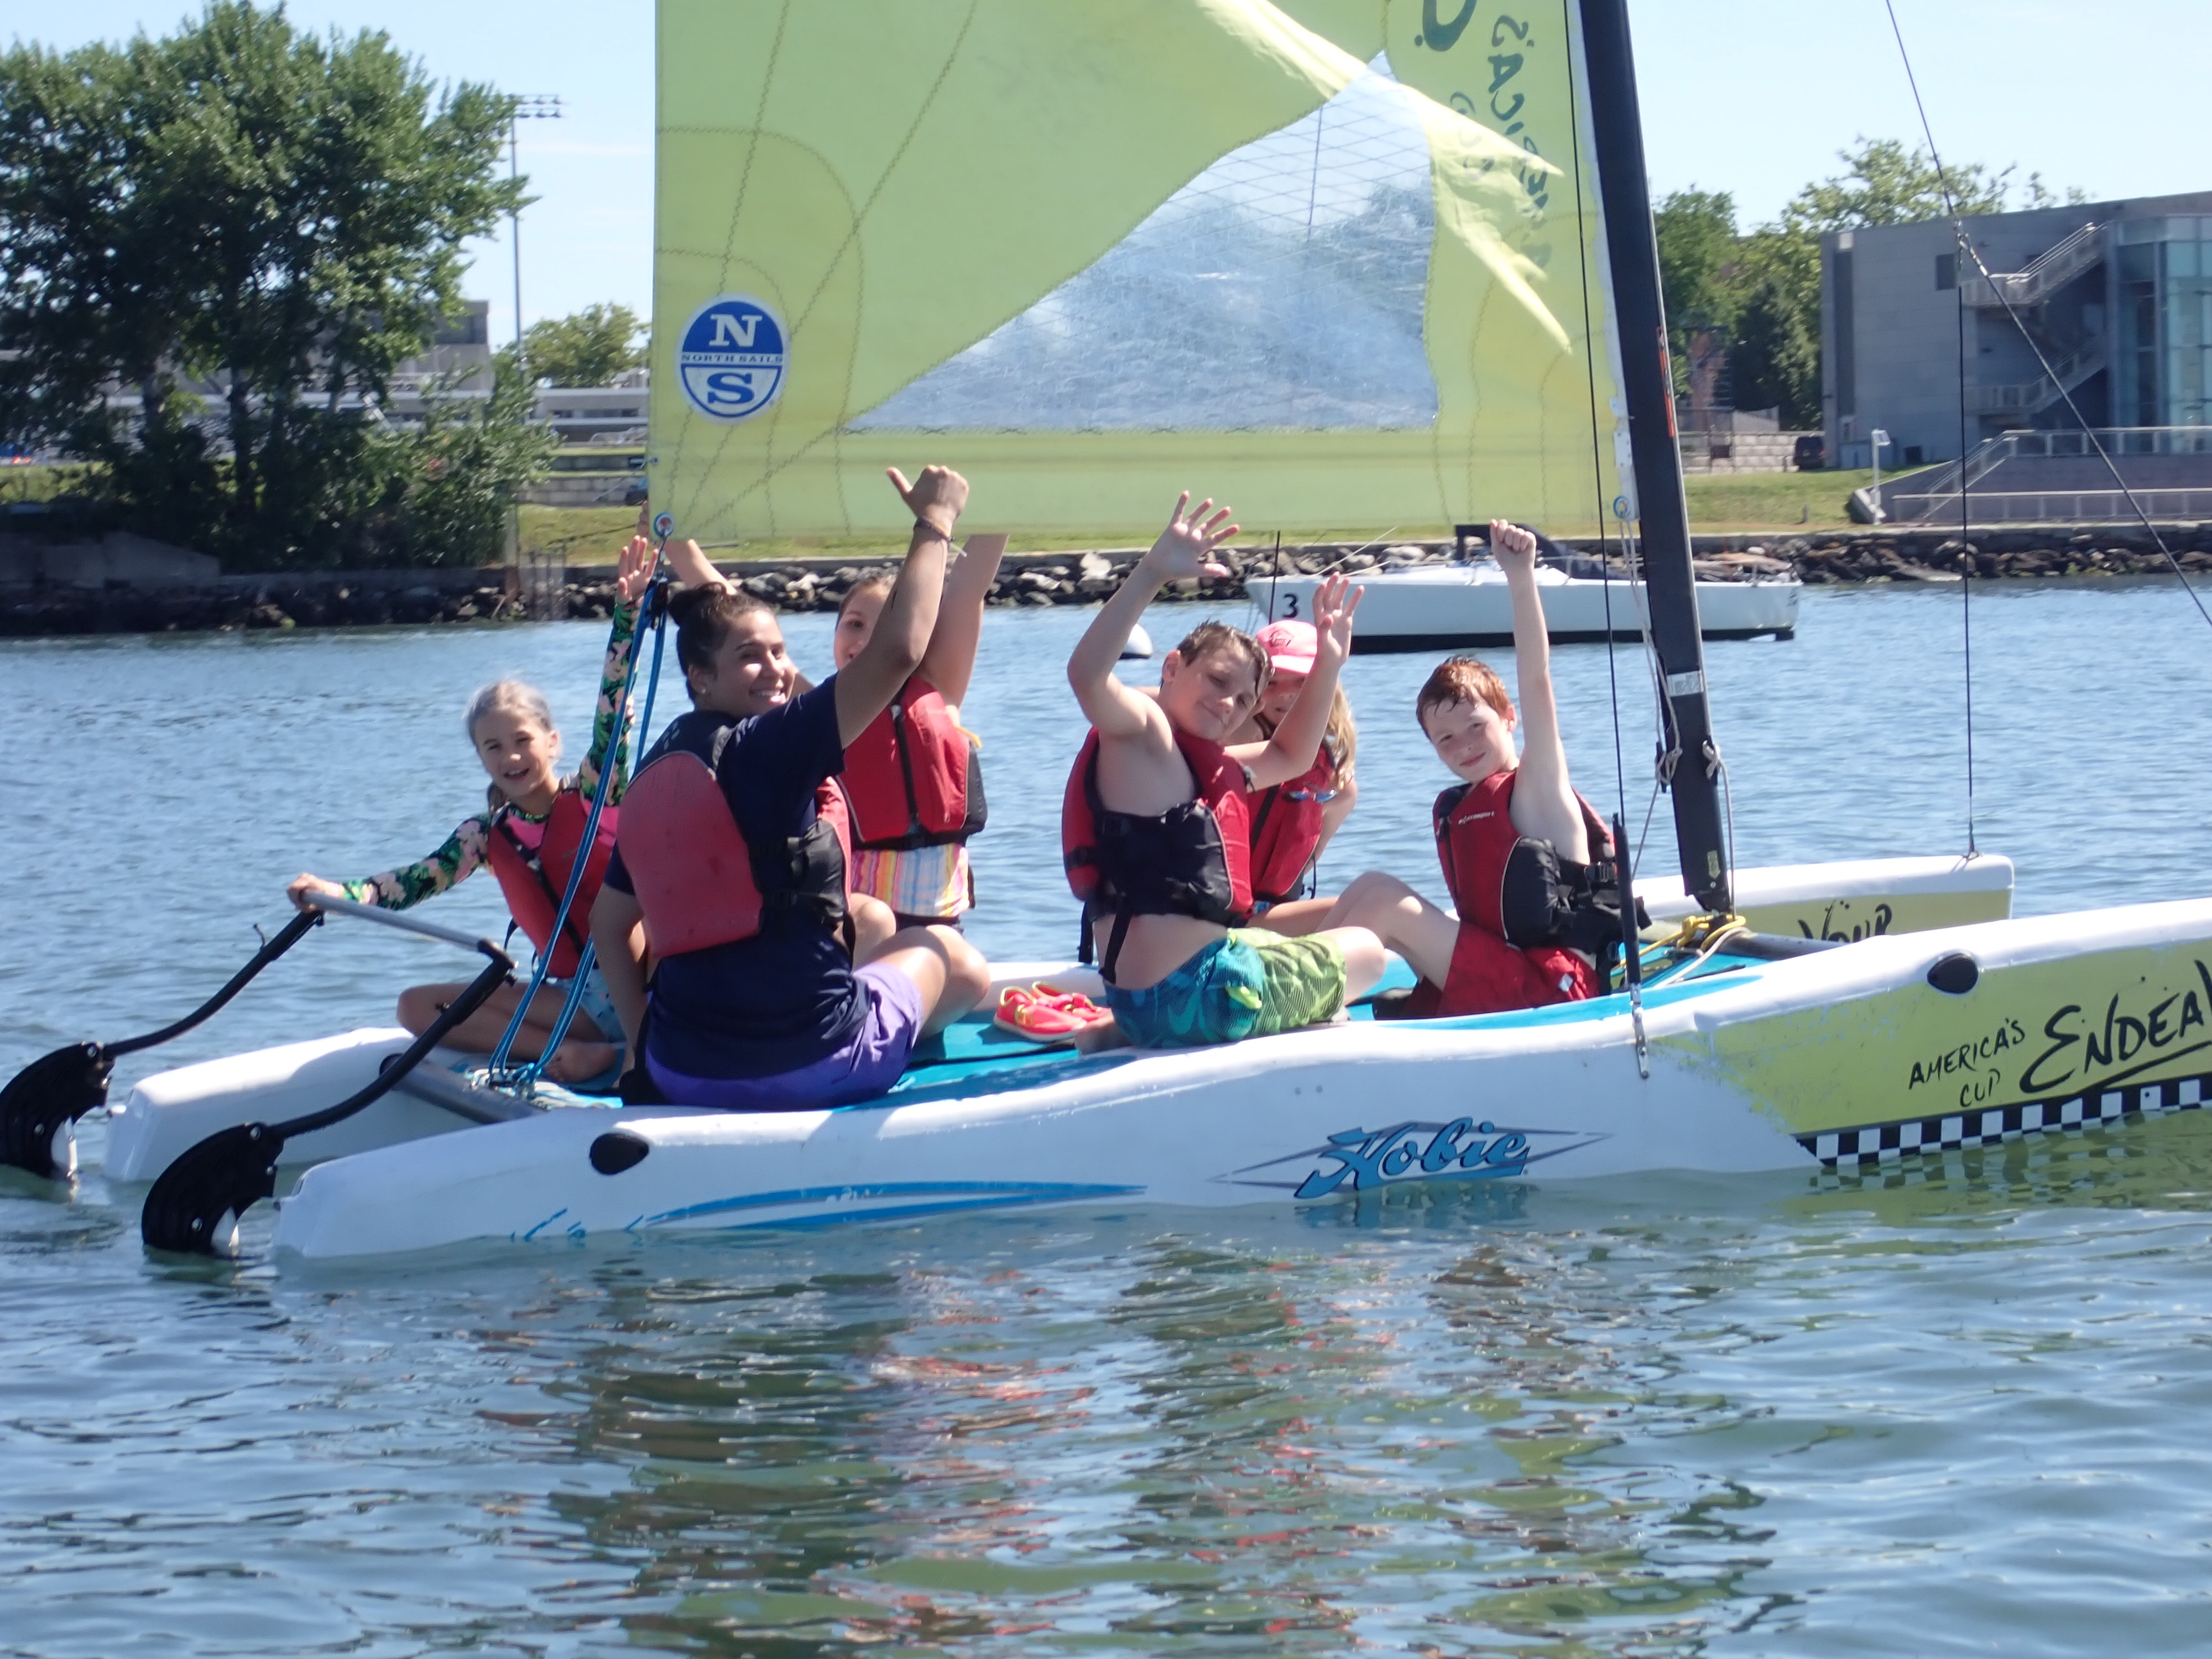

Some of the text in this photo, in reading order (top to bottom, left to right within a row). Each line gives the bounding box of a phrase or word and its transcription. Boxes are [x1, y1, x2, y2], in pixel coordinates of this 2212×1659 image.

[708, 314, 763, 347] N
[681, 354, 782, 363] NORTH SAILS
[707, 372, 755, 404] S
[1282, 593, 1298, 619] 3
[1908, 1018, 2026, 1090] AMERICA'S
[1959, 1068, 2001, 1108] CUP
[1293, 1116, 1531, 1199] Hobie
